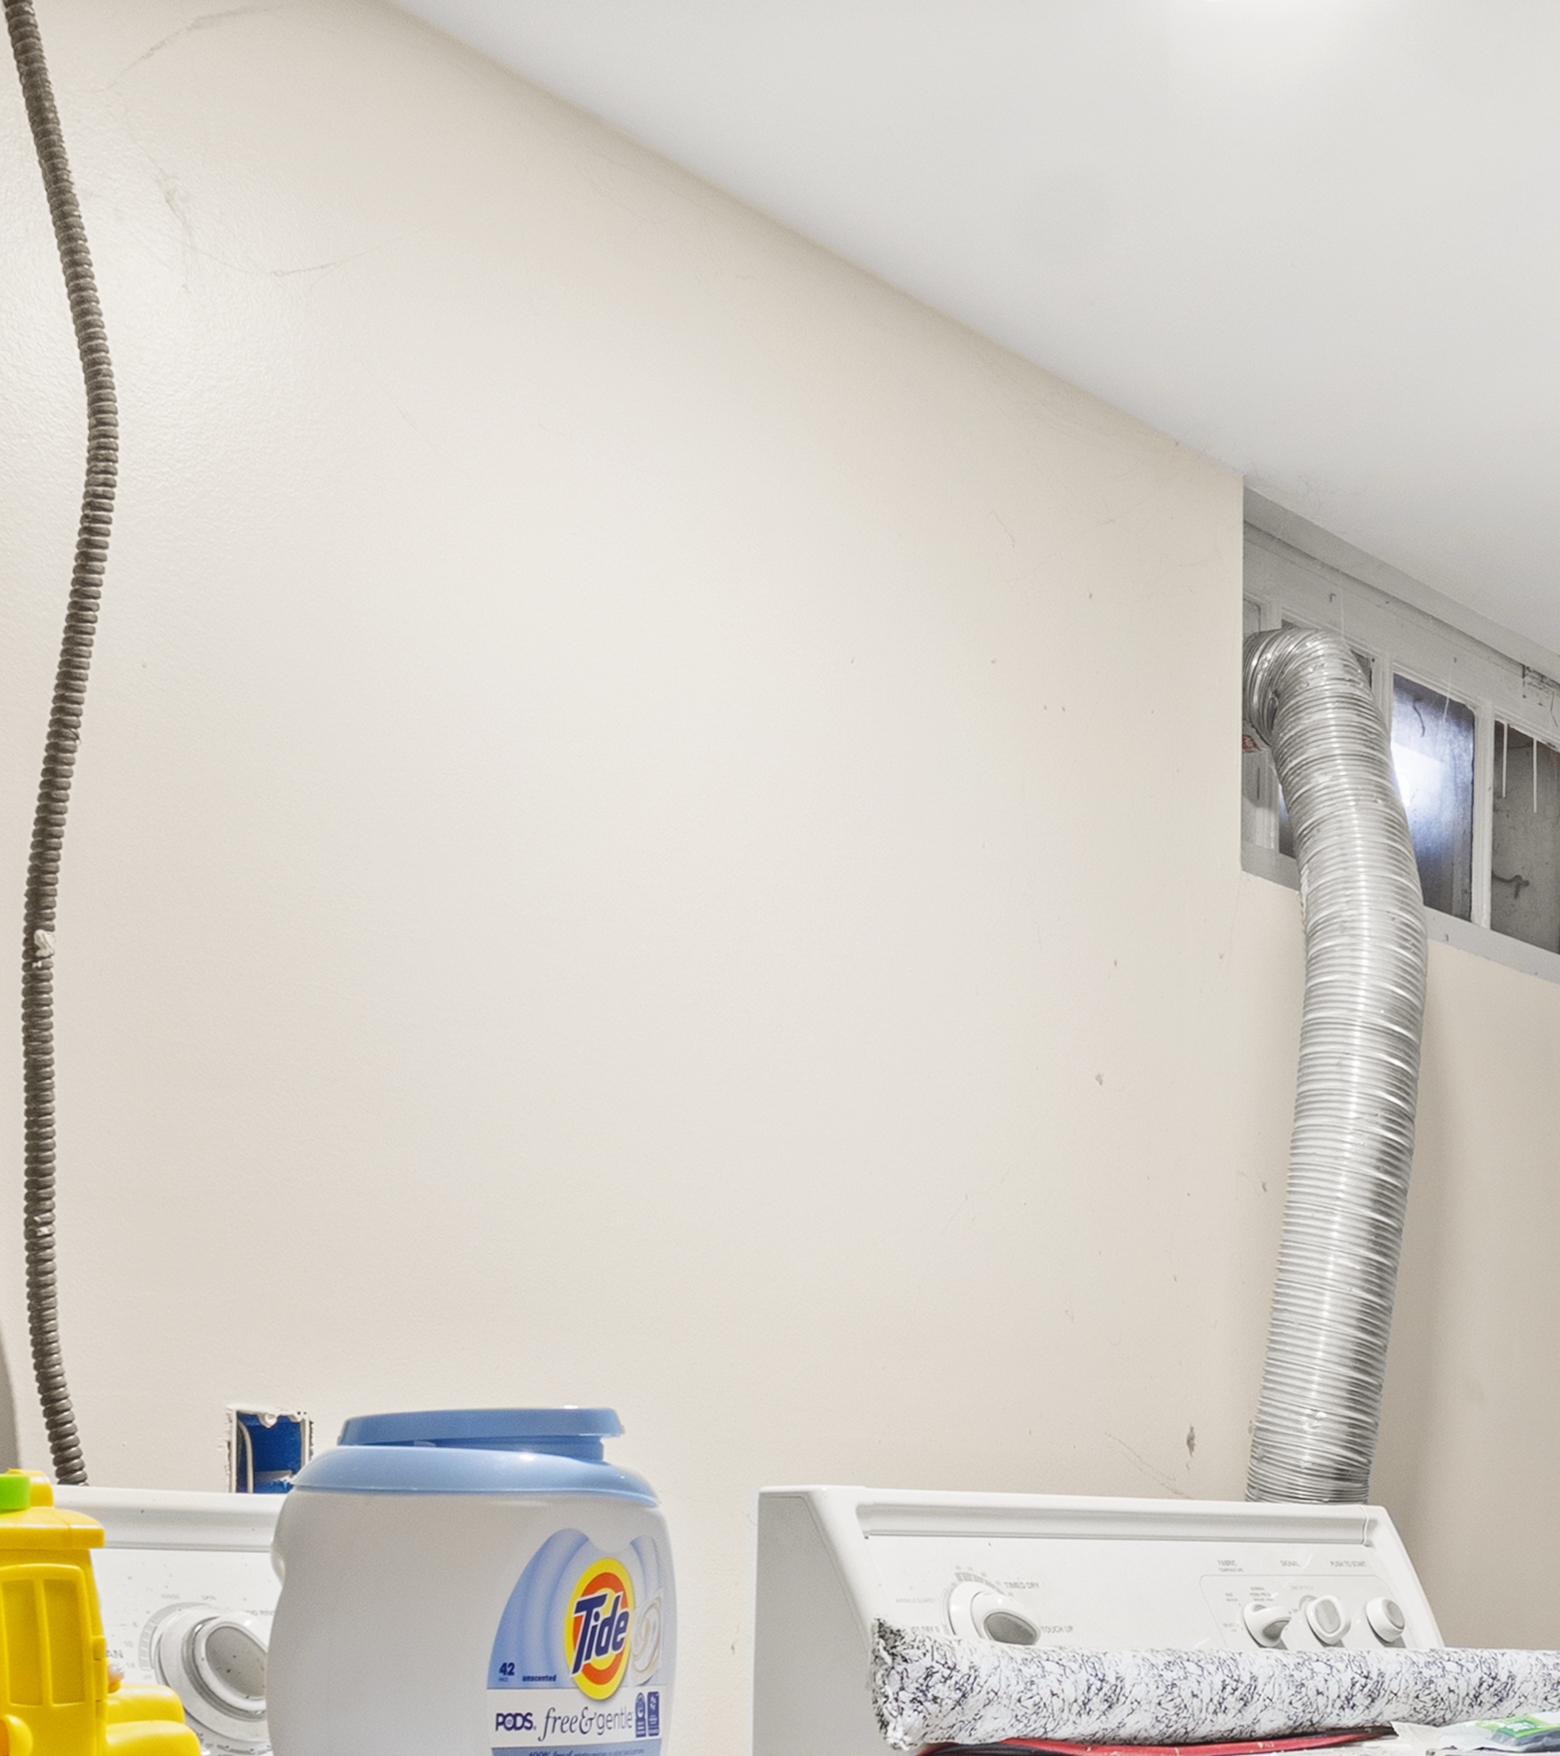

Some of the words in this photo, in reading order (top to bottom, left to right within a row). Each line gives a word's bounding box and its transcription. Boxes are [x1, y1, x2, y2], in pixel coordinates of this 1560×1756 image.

[571, 1591, 630, 1676] Tide
[499, 1662, 516, 1676] 42
[522, 1674, 557, 1683] unscented
